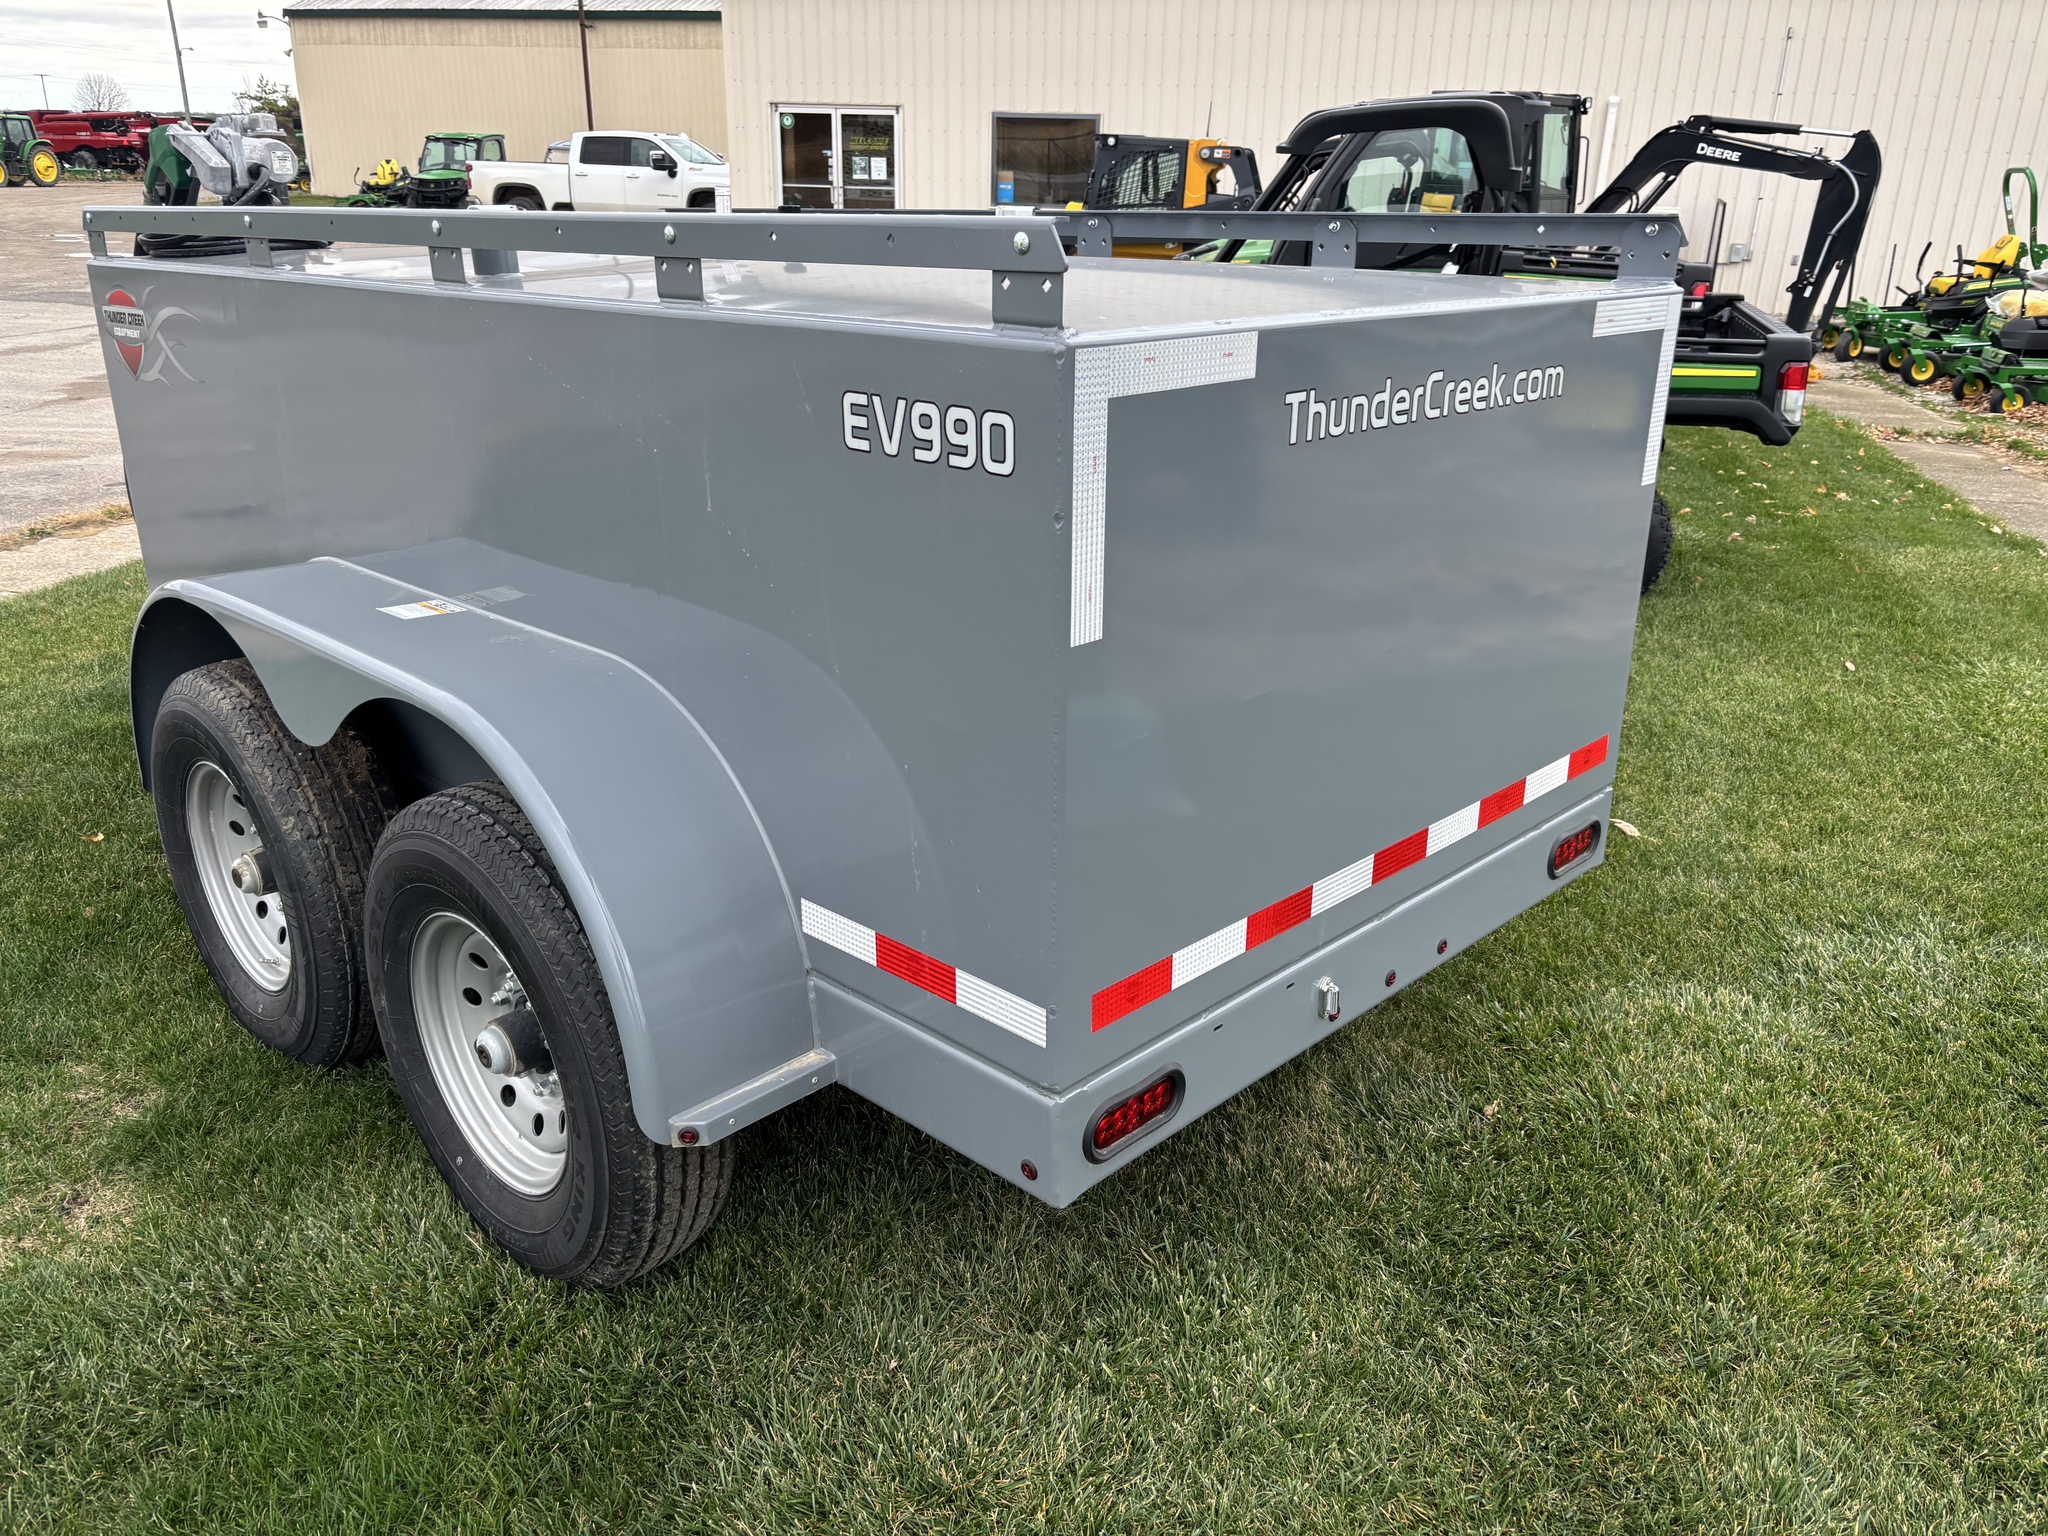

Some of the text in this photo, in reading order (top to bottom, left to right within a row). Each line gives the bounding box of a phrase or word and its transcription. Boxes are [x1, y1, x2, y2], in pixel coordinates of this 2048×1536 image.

[1696, 142, 1742, 162] DEERE
[104, 310, 145, 326] THUNDER CREEK
[114, 327, 140, 338] EQUIPMENT
[1284, 362, 1565, 446] ThunderCreek.com
[842, 390, 1016, 478] EV990
[561, 1160, 585, 1243] KING
